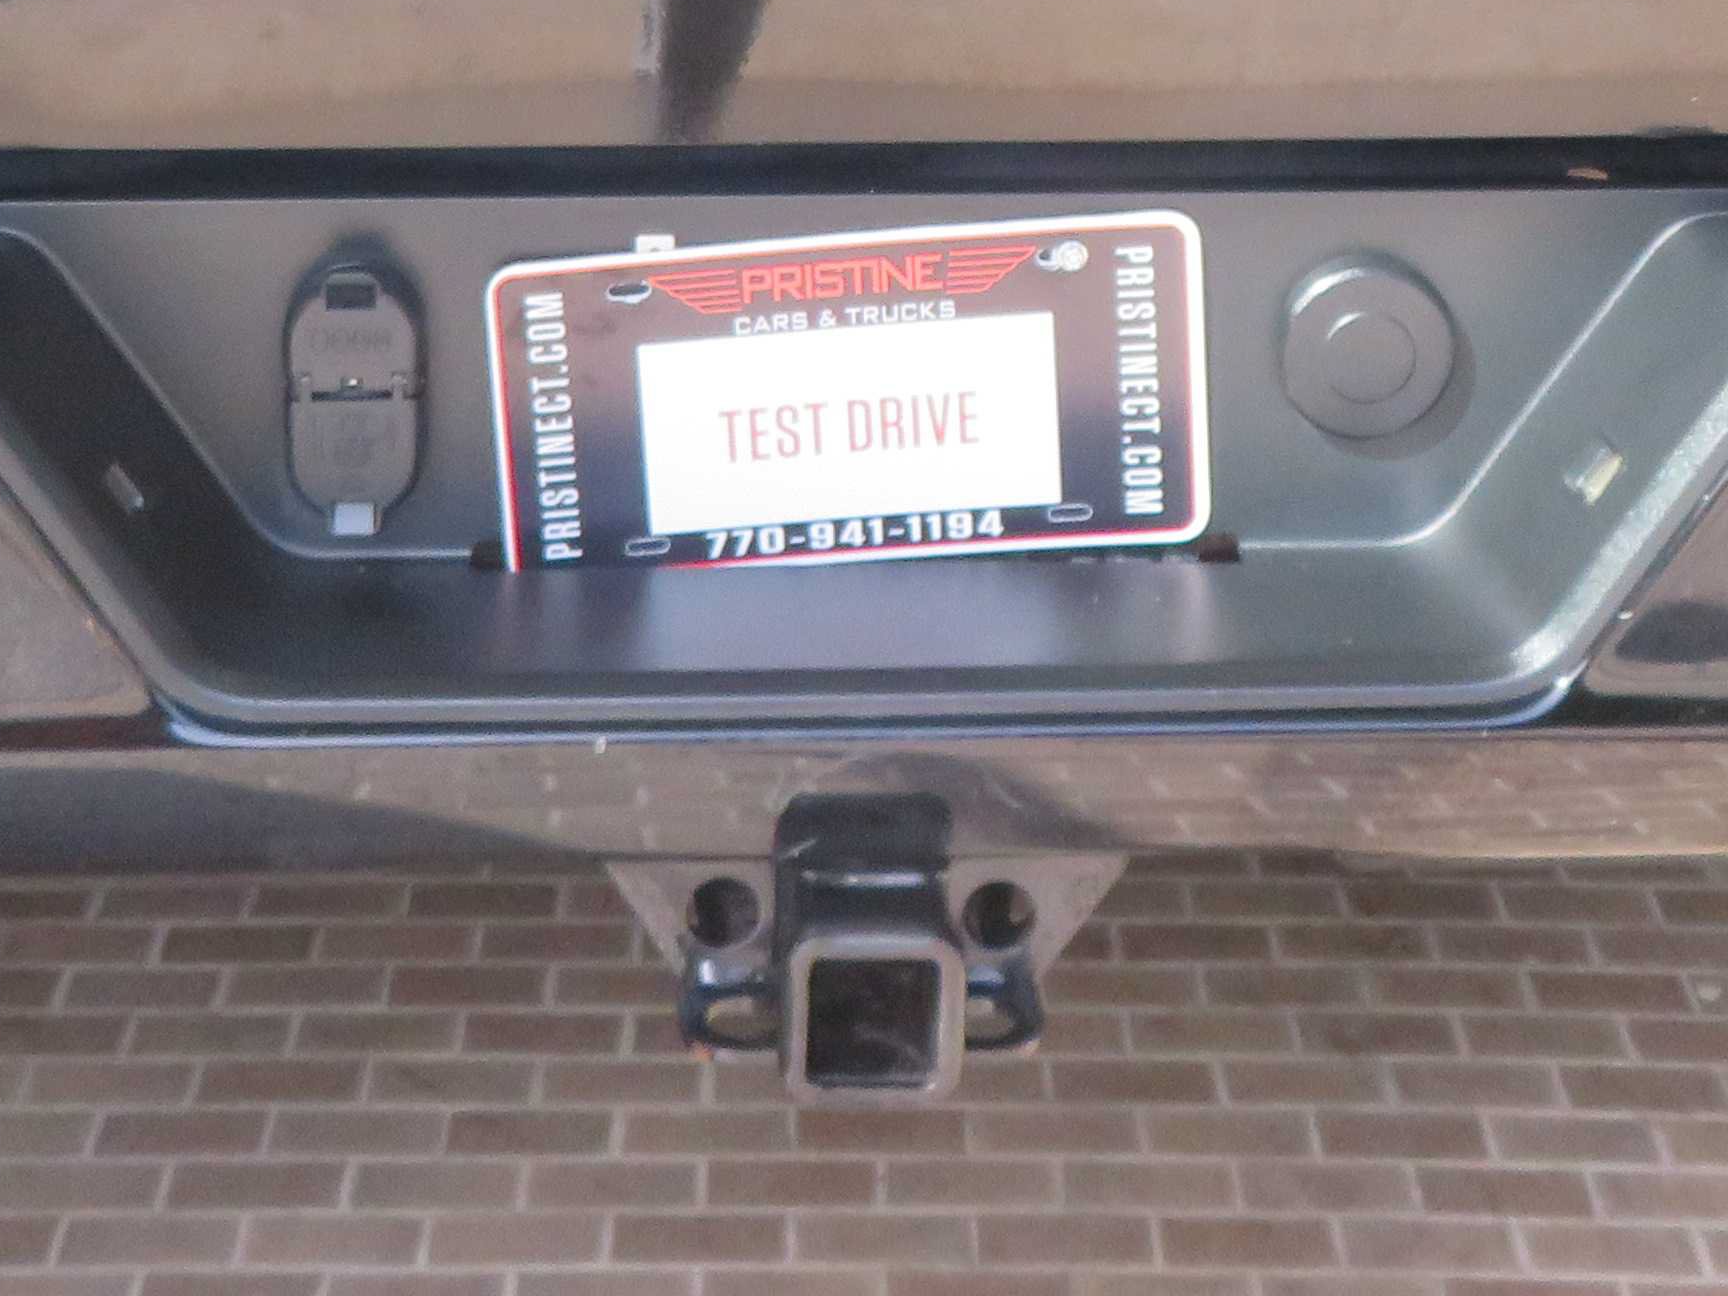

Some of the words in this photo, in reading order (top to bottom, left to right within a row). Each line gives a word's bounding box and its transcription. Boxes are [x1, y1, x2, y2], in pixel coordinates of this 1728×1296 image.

[741, 252, 946, 305] PRISTINE
[733, 312, 810, 337] CARS
[818, 307, 837, 328] &
[845, 299, 957, 327] TRUCKS
[1115, 245, 1164, 515] PRISTINECT.COM
[524, 292, 584, 561] PRISTINECT.COM
[719, 401, 829, 464] TEST
[848, 392, 979, 452] DRIVE
[704, 511, 1004, 560] 770-941-1194
